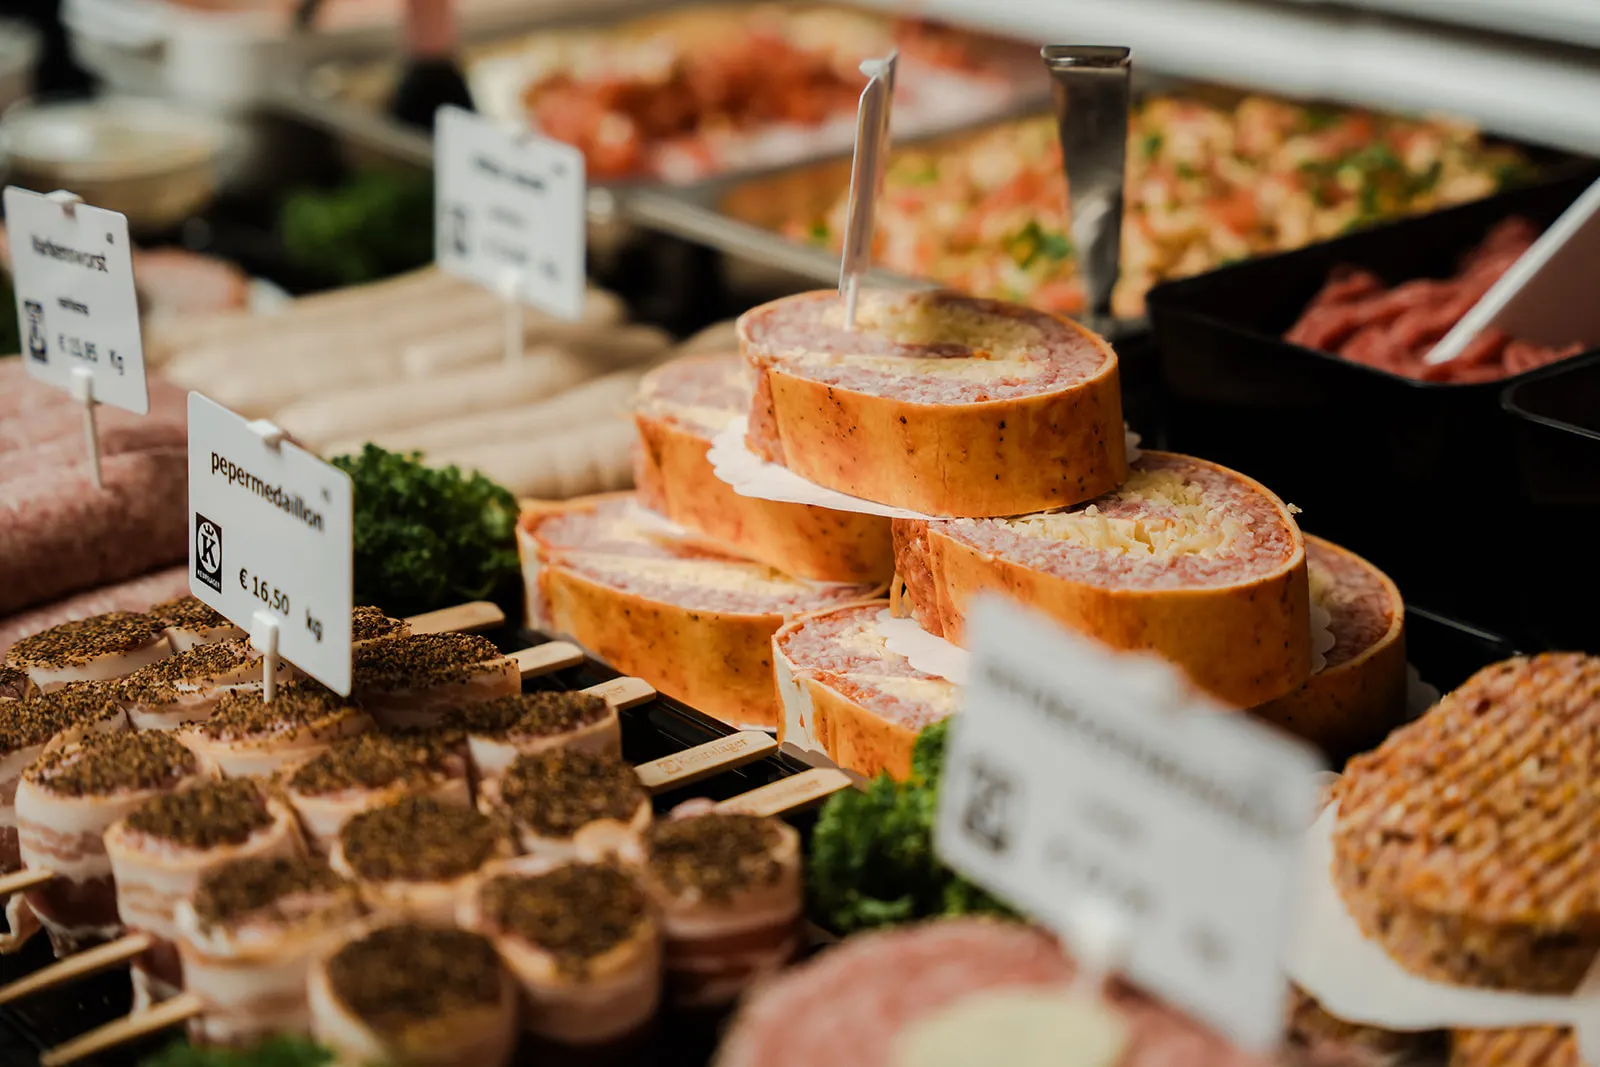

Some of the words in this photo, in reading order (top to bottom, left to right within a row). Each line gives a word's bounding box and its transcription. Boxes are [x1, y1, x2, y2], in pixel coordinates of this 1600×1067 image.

[211, 450, 325, 532] pepermedaillon
[201, 533, 217, 571] K
[239, 568, 248, 590] €
[253, 576, 290, 616] 16,50
[305, 609, 323, 643] kg
